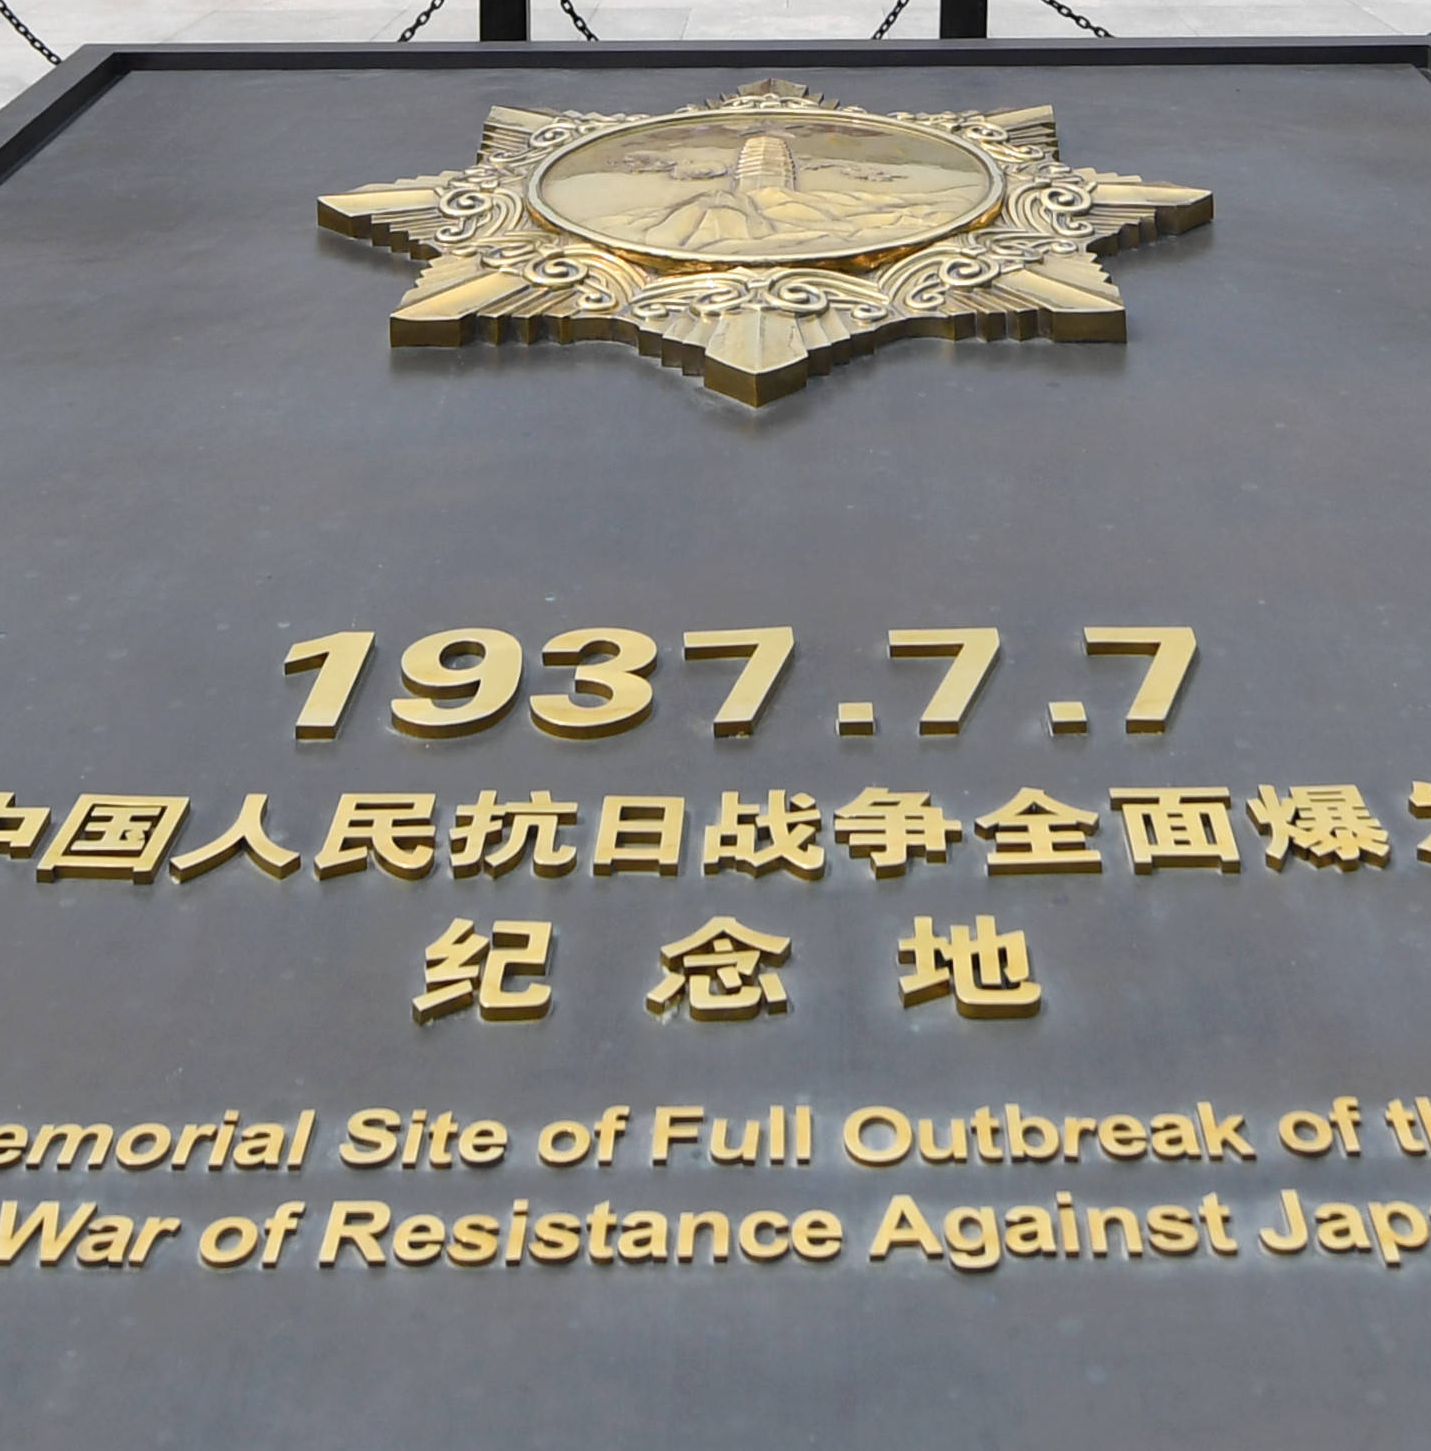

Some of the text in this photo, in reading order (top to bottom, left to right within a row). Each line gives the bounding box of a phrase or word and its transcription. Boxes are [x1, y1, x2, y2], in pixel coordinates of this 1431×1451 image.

[283, 625, 1200, 741] 1937.7.7
[412, 913, 1044, 1025] 纪念地
[339, 1107, 509, 1167] Site
[537, 1105, 631, 1167] of
[651, 1104, 813, 1165] Full
[842, 1102, 1259, 1165] Outbreak
[1277, 1096, 1363, 1157] of
[197, 1201, 307, 1267] of
[319, 1197, 845, 1267] Resistance
[868, 1191, 1241, 1271] Against
